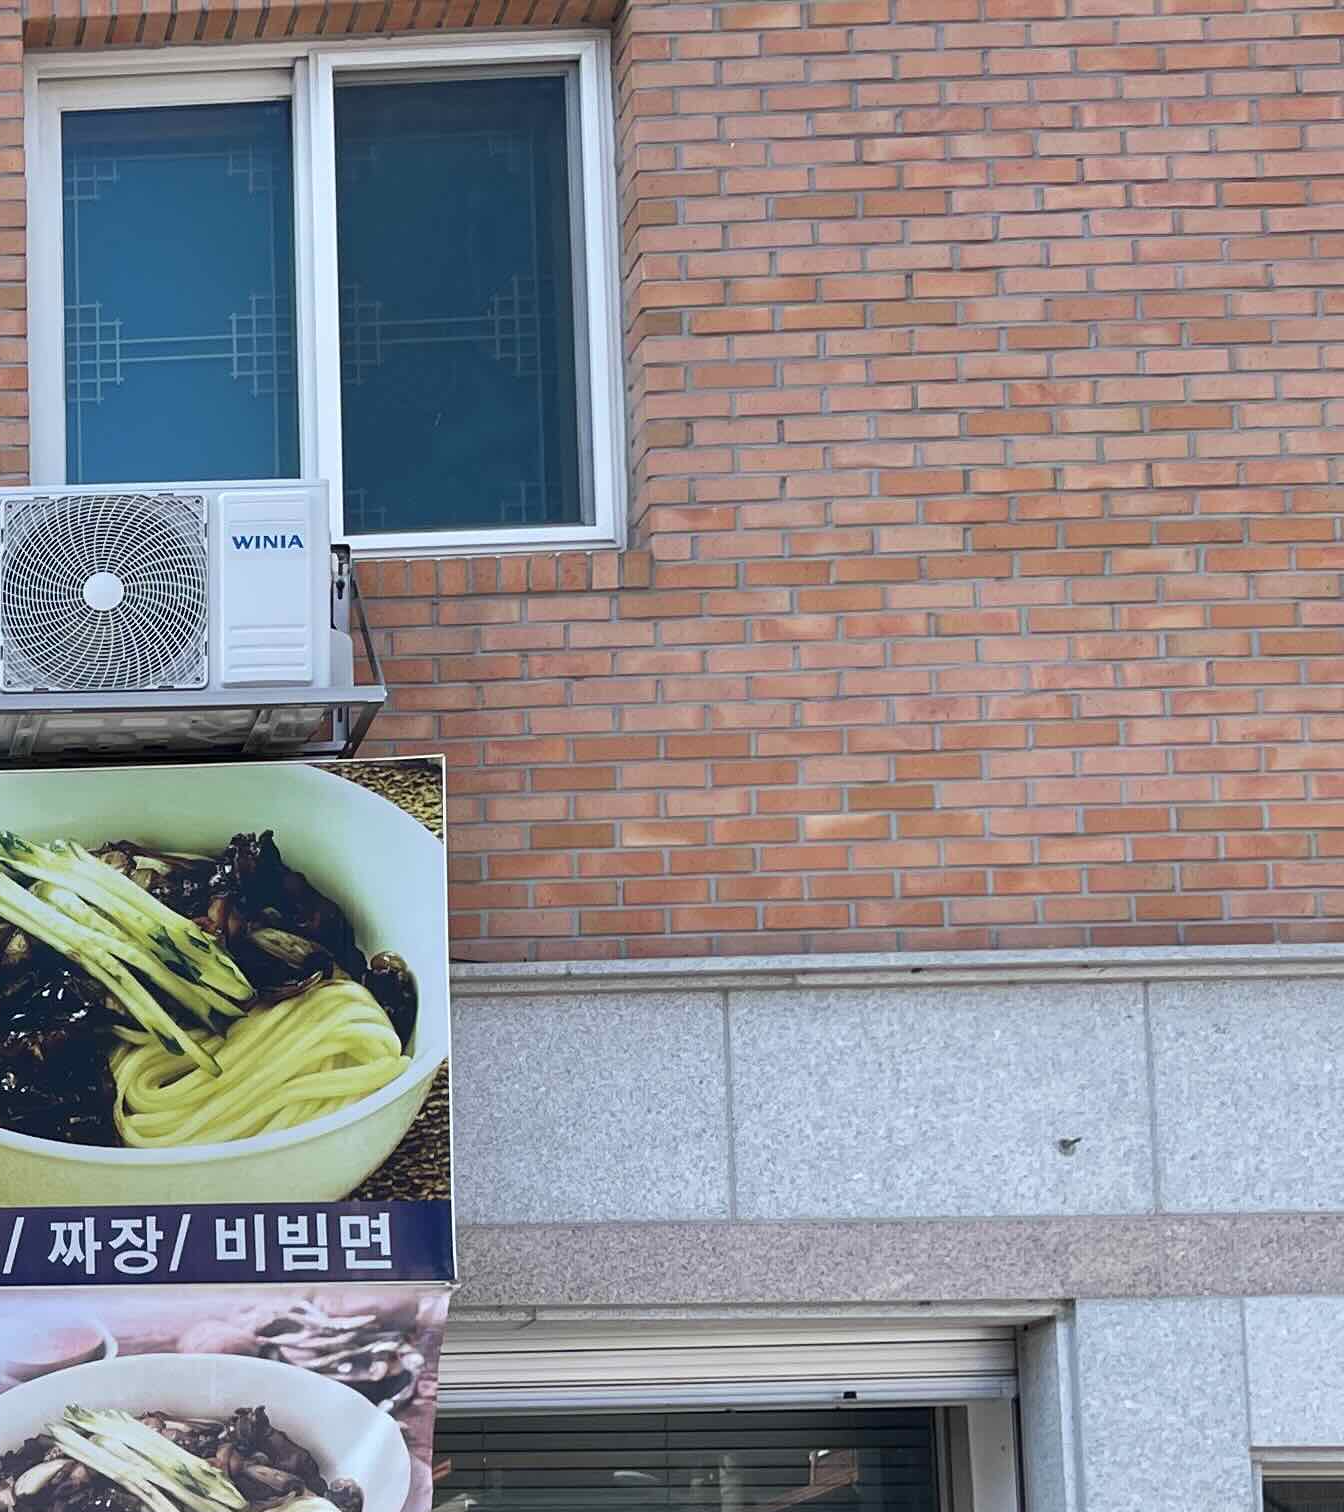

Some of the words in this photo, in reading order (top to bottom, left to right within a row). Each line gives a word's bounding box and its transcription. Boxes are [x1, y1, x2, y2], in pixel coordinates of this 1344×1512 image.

[231, 534, 304, 550] WINIA
[47, 1212, 191, 1274] 짜장/
[215, 1209, 394, 1272] 비빔면
